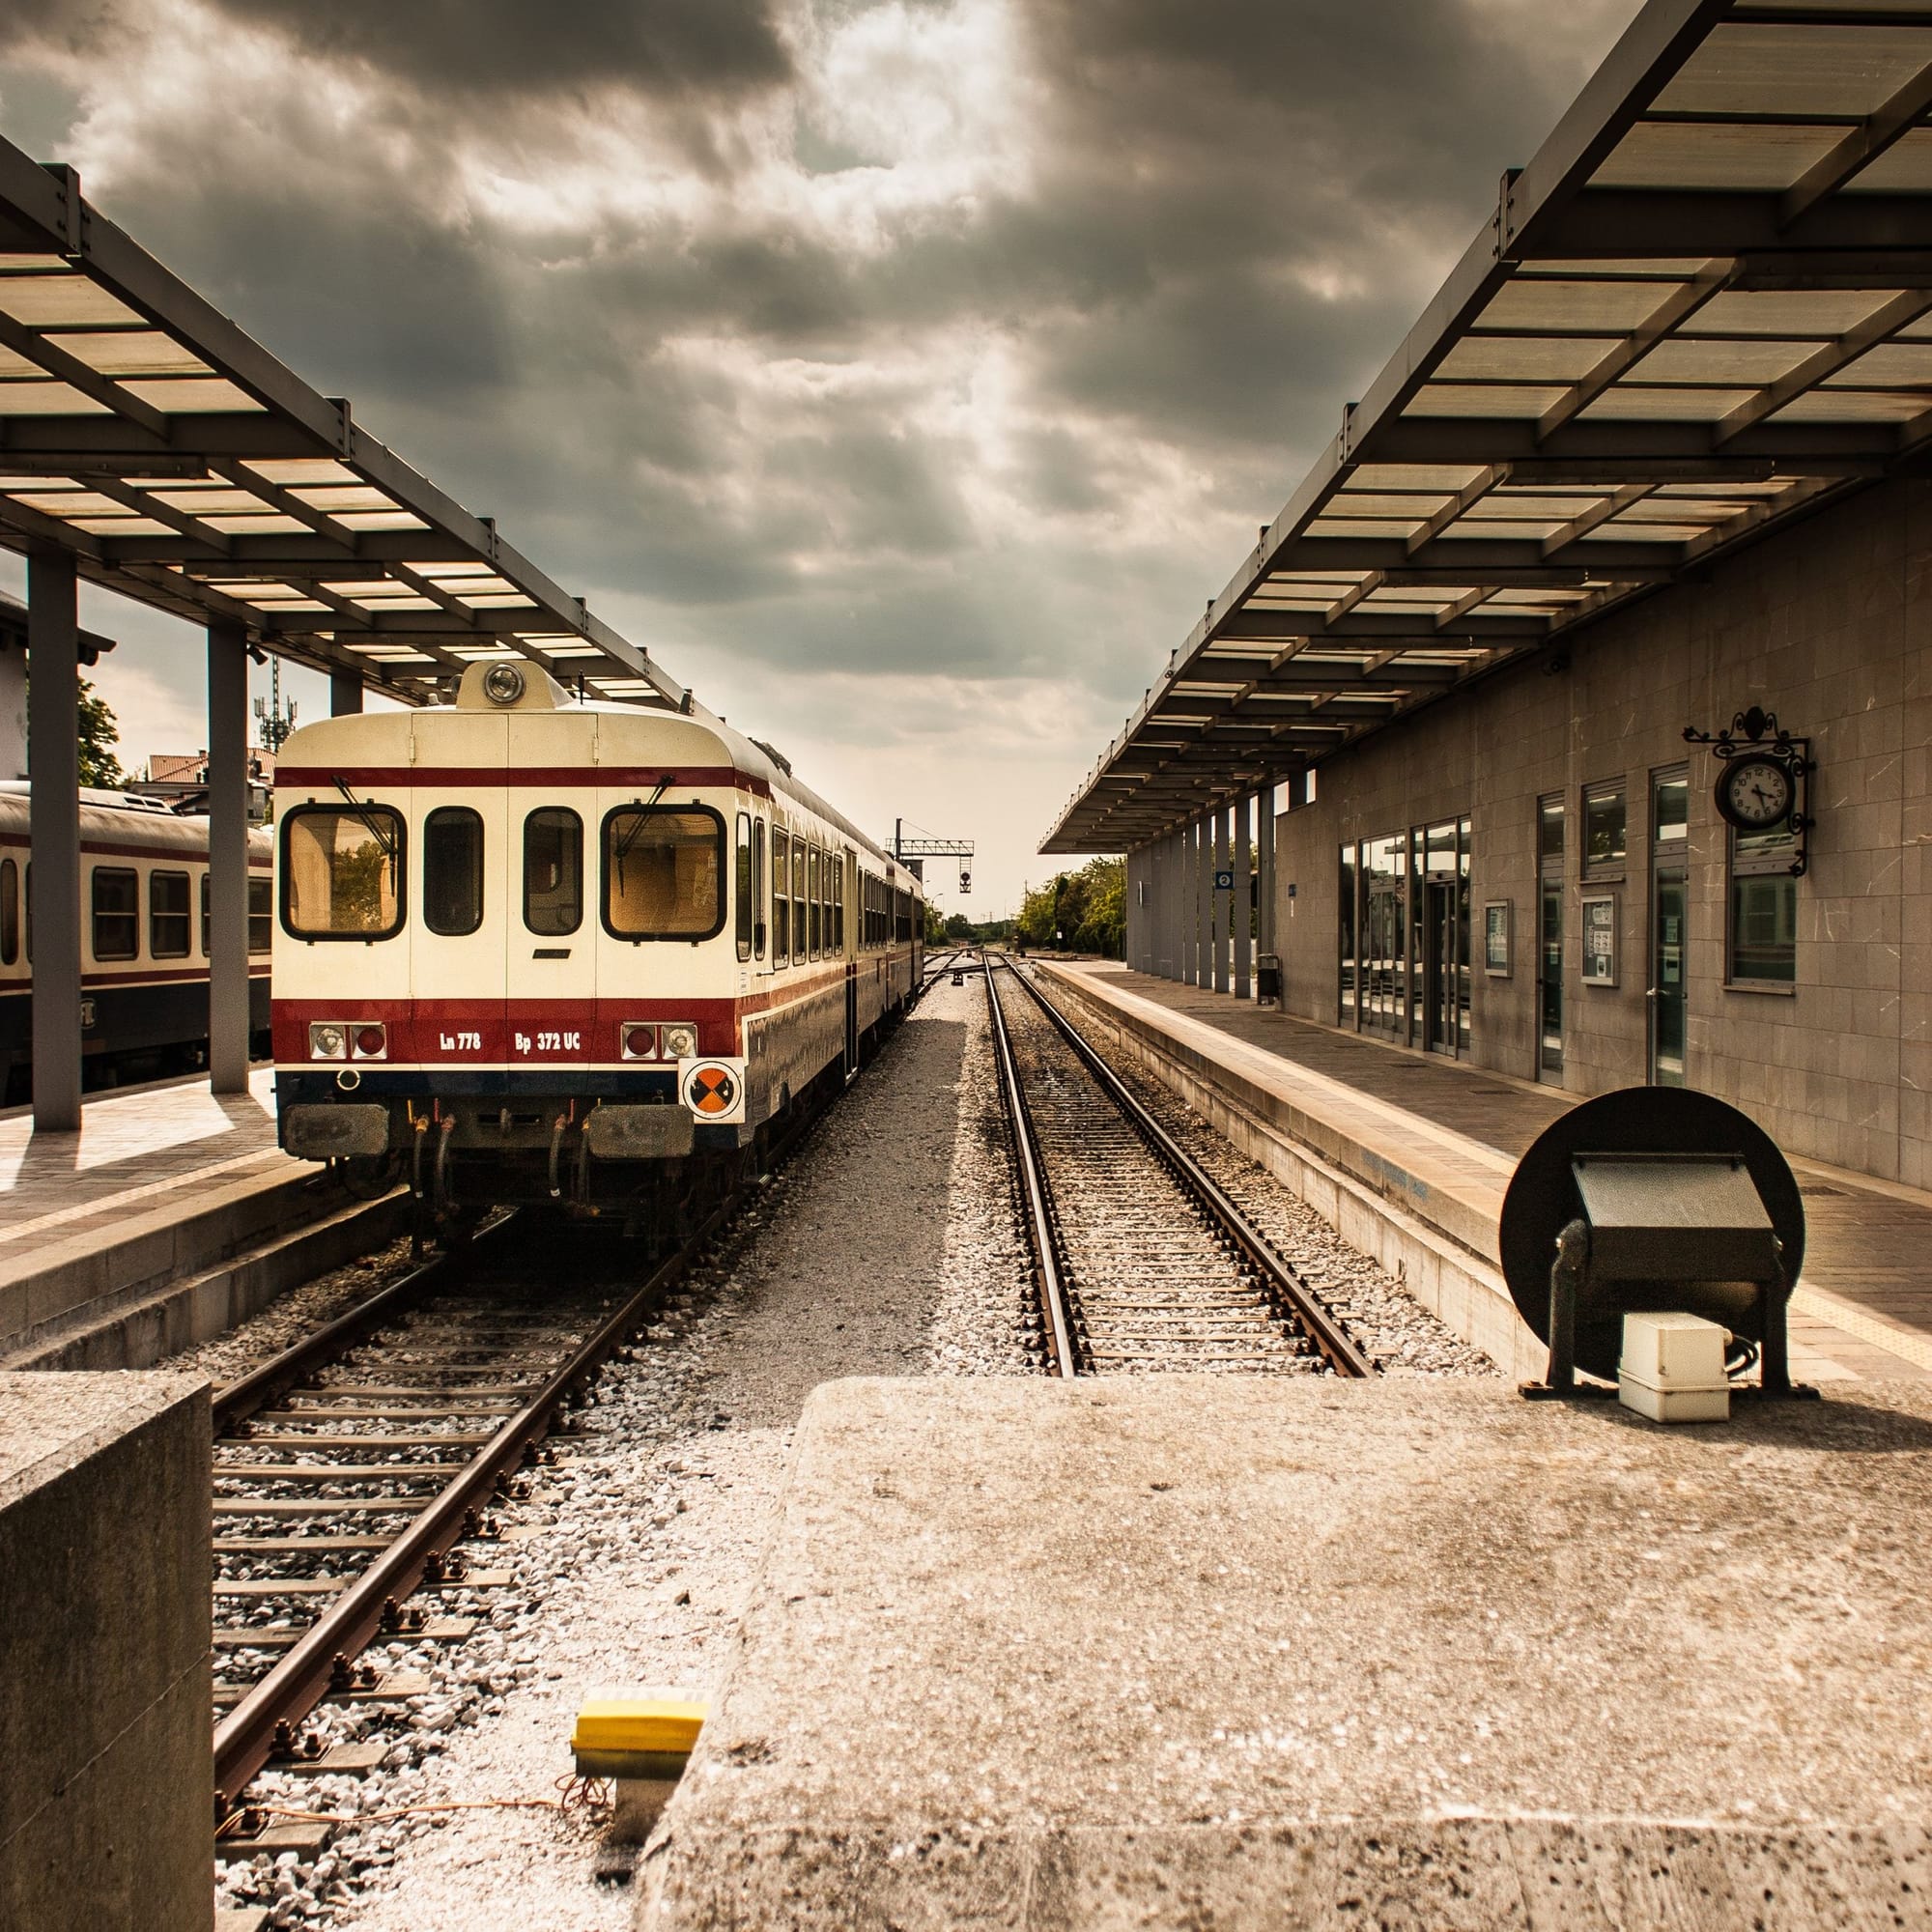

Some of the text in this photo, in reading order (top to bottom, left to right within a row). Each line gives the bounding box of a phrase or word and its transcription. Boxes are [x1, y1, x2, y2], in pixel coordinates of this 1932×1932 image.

[1734, 788, 1740, 797] 9
[1738, 799, 1744, 808] 8
[440, 1033, 481, 1050] Ln 778
[515, 1033, 581, 1055] Bp 372 UC
